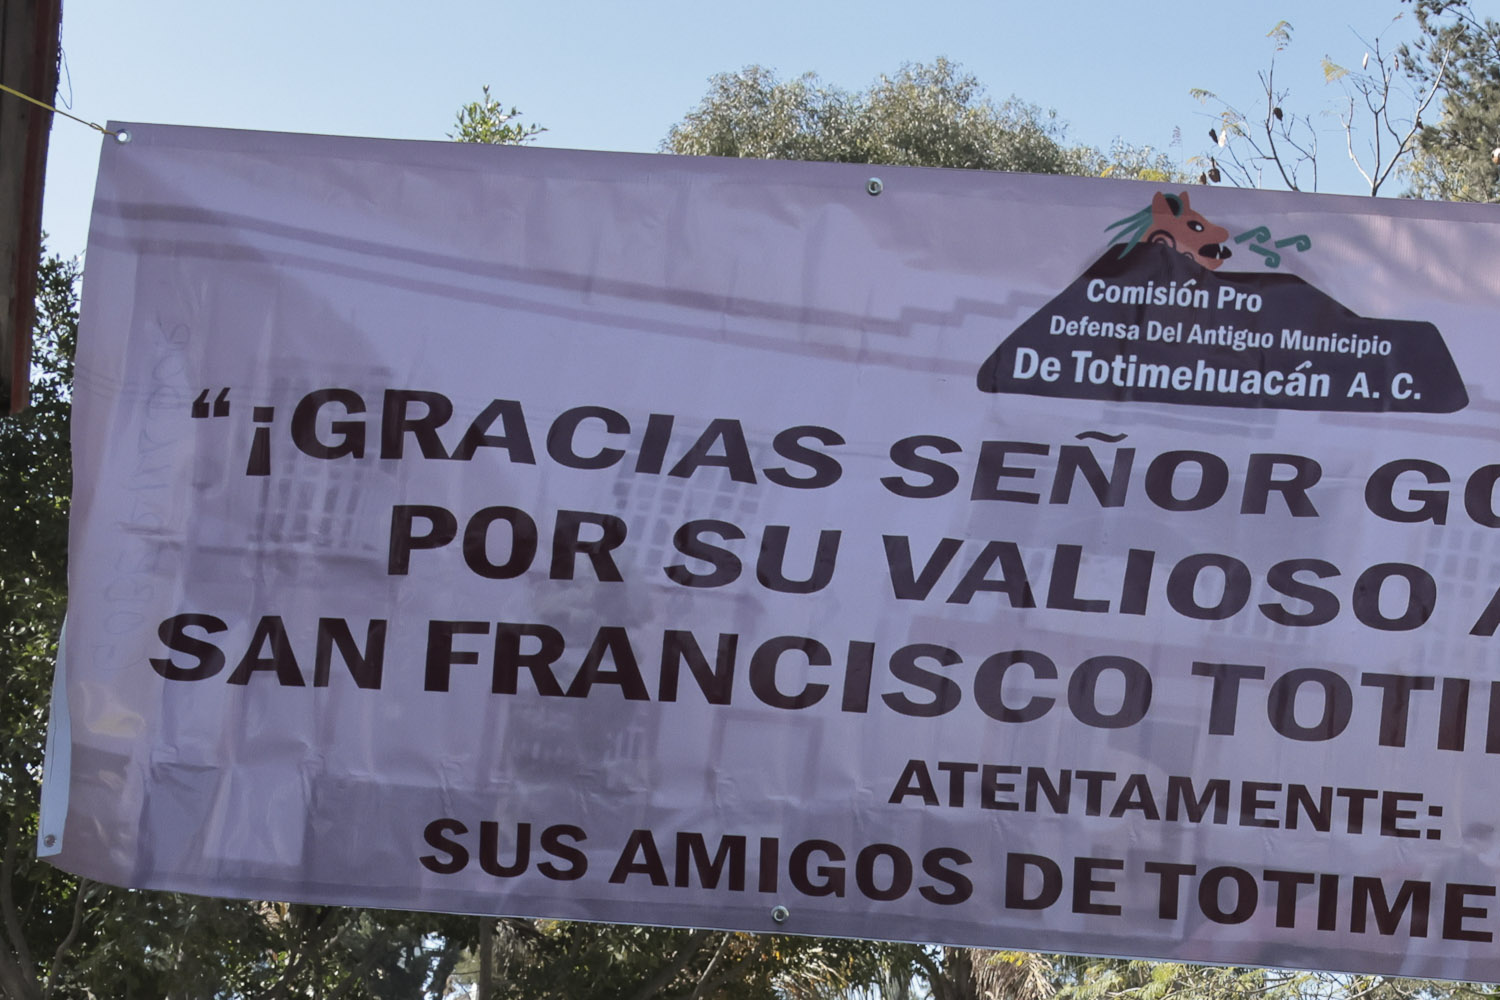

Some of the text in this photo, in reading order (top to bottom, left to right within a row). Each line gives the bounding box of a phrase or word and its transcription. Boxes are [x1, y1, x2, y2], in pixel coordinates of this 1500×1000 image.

[1087, 279, 1261, 312] Comisión Pro
[1013, 348, 1420, 399] De Totimehuacán A. C.
[1050, 316, 1391, 358] Defensa Del Antiguo Municipio
[880, 431, 1322, 517] SEÑOR
[387, 505, 627, 583] POR
[664, 520, 841, 594] SU
[882, 535, 1436, 631] VALIOSO
[149, 613, 387, 690] SAN
[424, 620, 1152, 729] FRANCISCO
[889, 760, 1443, 839] ATENTAMENTE:
[419, 817, 589, 881] SUS
[609, 829, 973, 907] AMIGOS
[1004, 852, 1124, 917] DE
